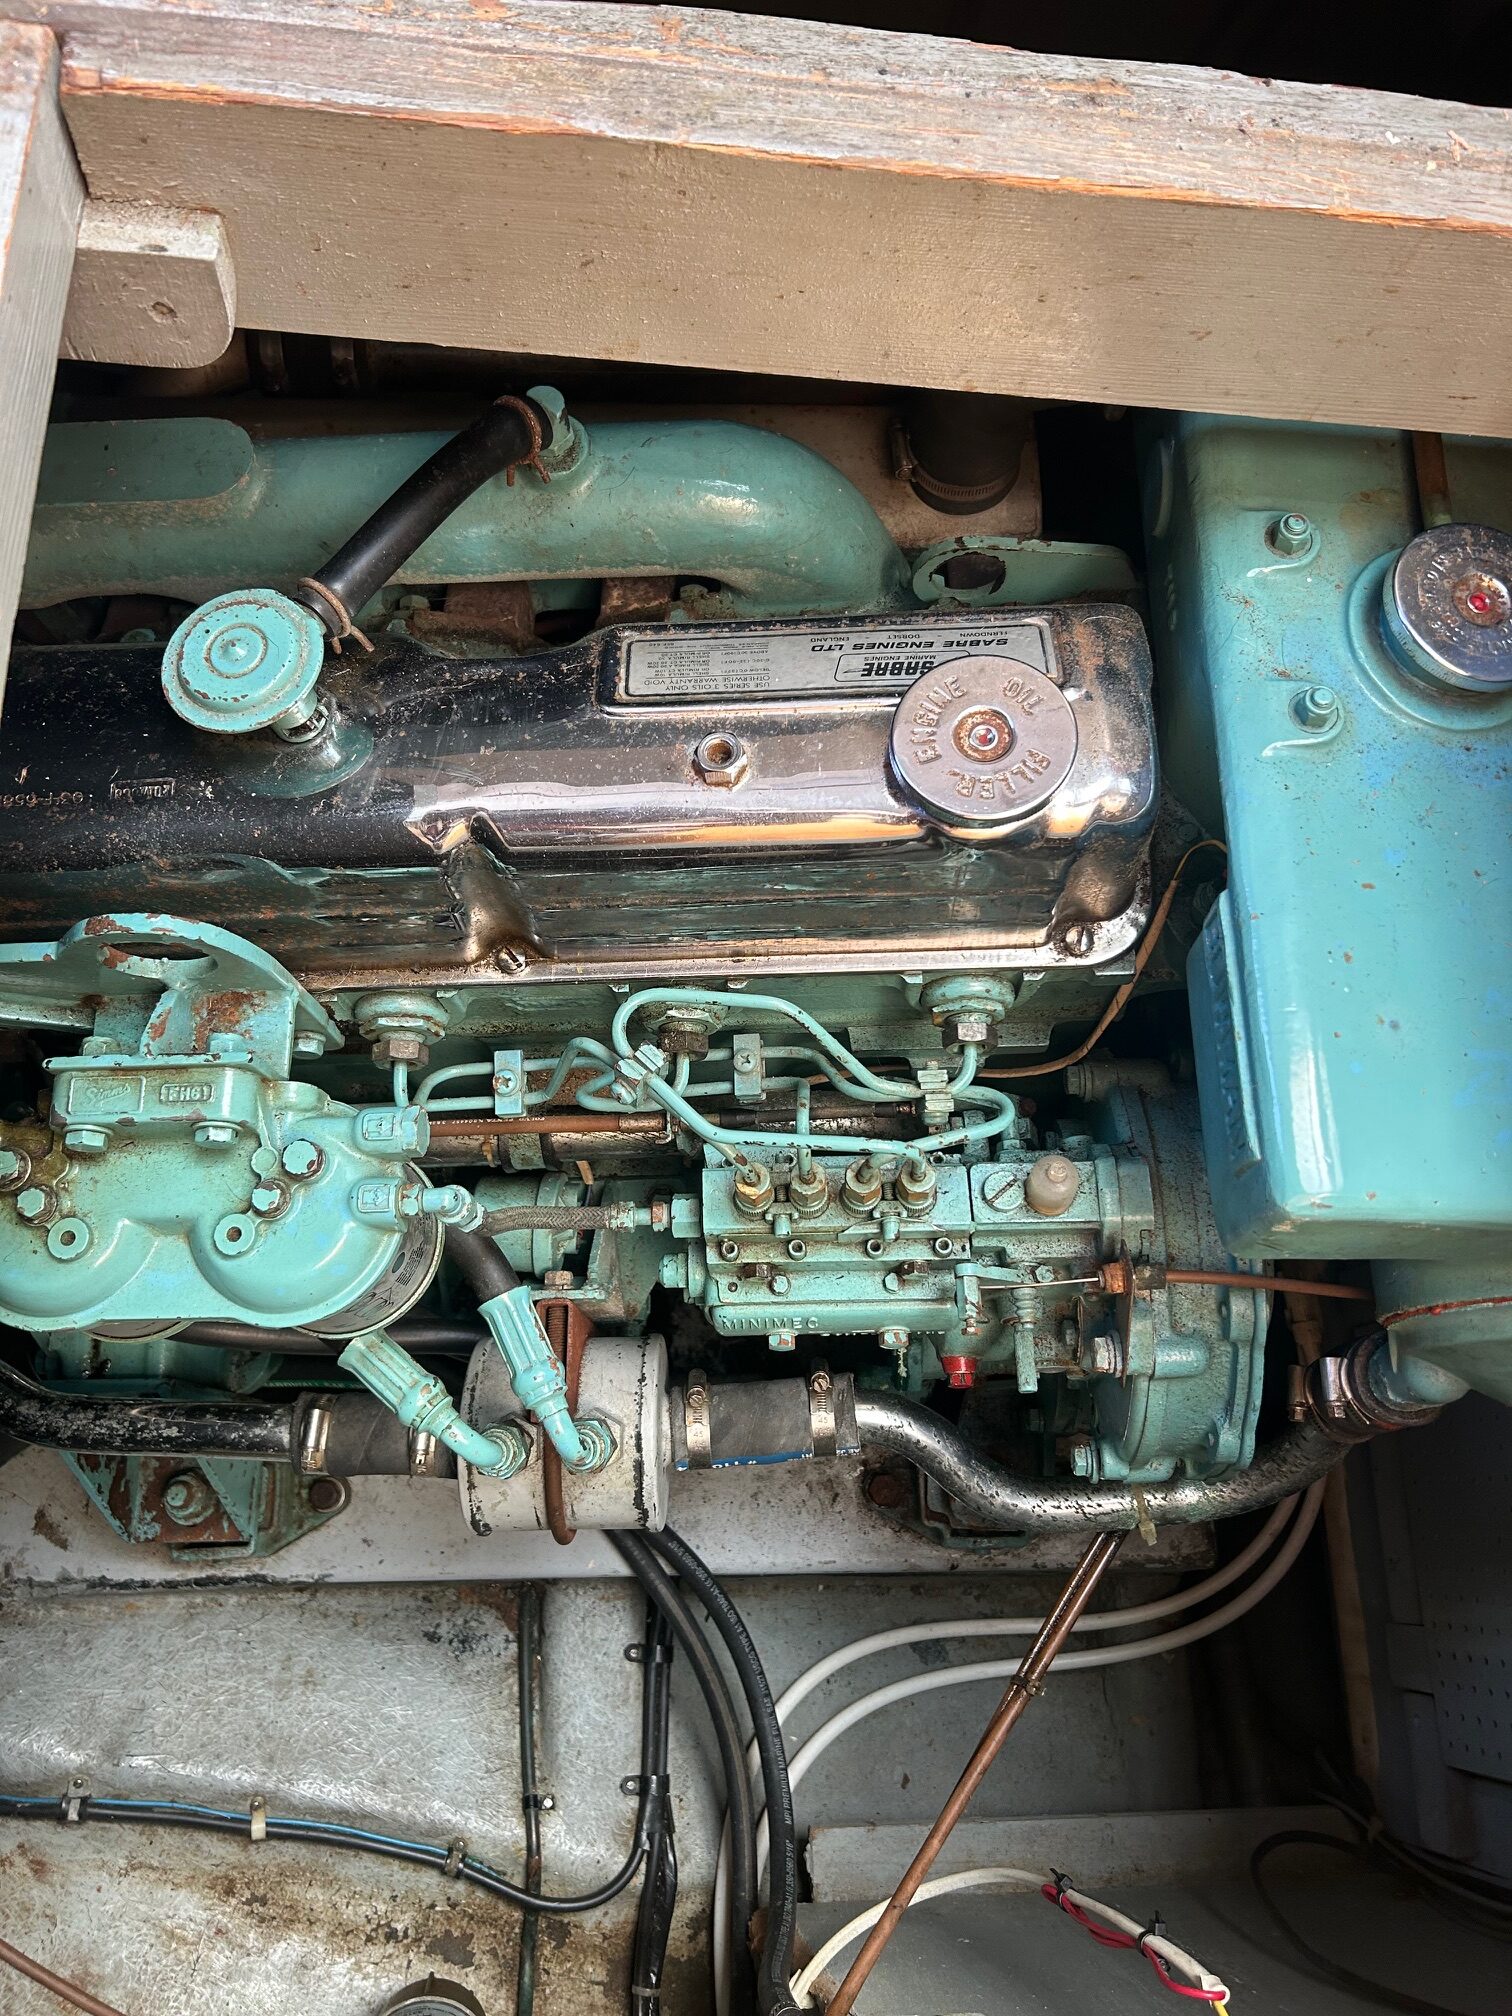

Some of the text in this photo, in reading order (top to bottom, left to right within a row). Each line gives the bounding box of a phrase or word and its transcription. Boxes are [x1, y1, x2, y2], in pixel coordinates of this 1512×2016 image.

[812, 638, 1008, 652] SABRE ENGINES LTD
[861, 661, 934, 677] SABRE
[910, 676, 1052, 799] ENGINE OIL FILLER
[86, 1083, 131, 1105] Simms
[722, 1316, 819, 1330] MINIMEC
[739, 1631, 756, 1654] TYPE
[773, 1736, 787, 1768] MARINE
[780, 1770, 791, 1809] PREMIUM
[784, 1810, 792, 1824] MPI
